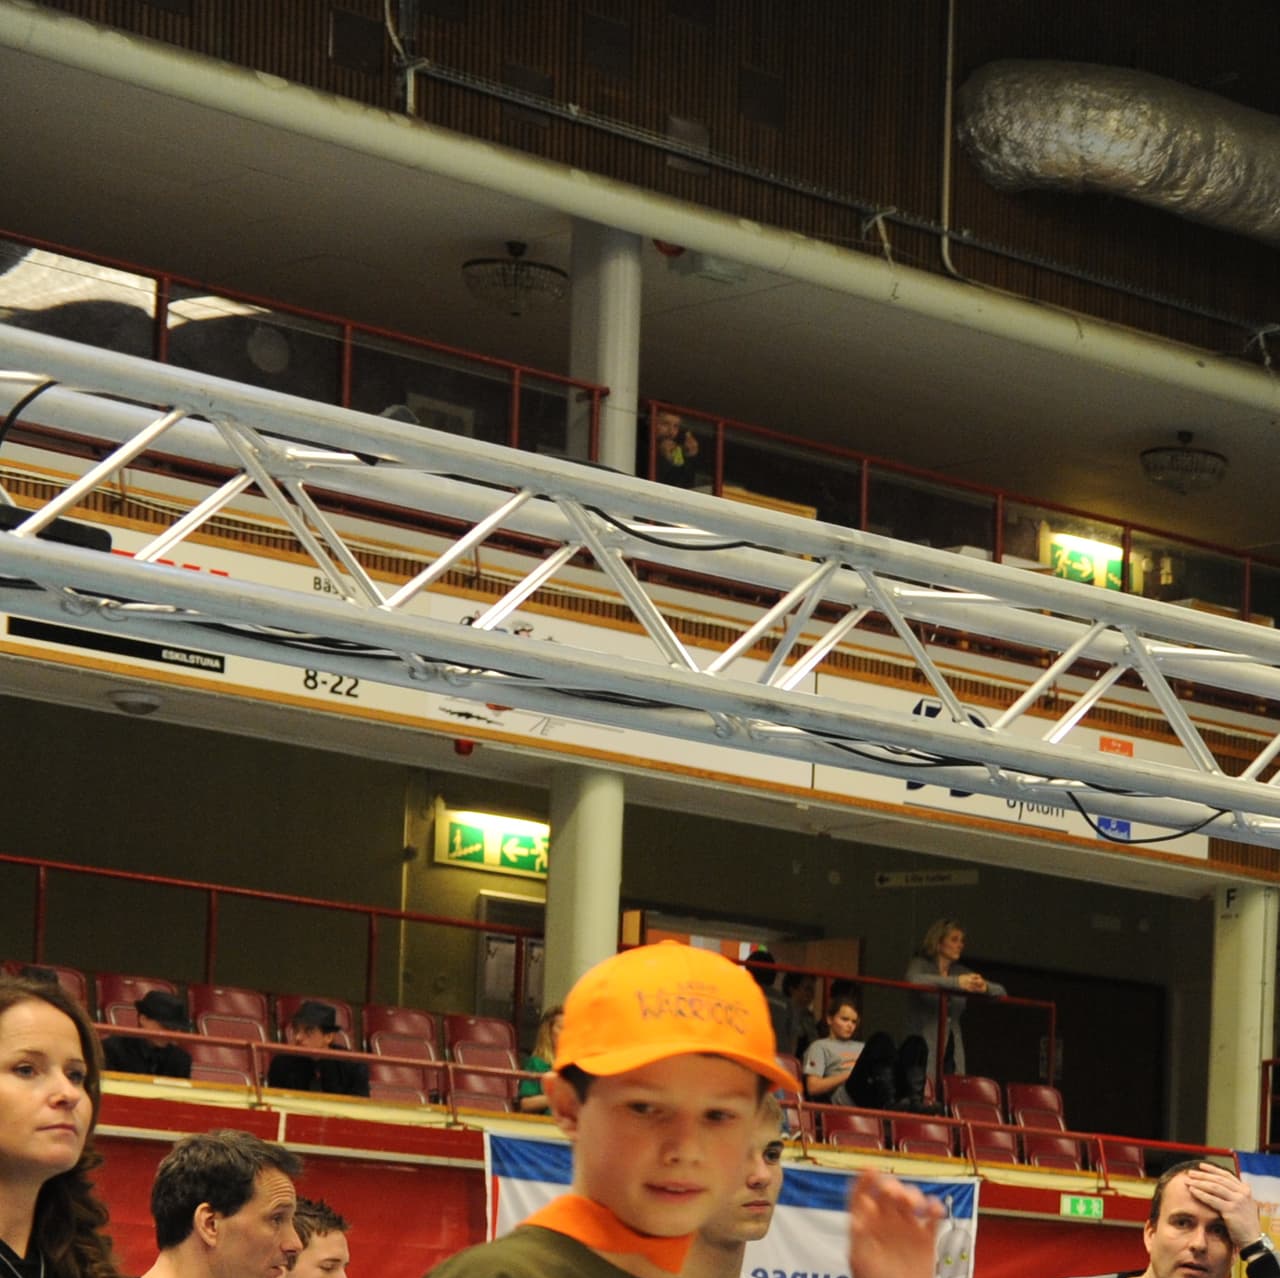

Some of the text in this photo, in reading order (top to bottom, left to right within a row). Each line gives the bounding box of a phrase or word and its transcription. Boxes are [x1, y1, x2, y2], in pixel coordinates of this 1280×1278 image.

[161, 648, 222, 669] ESKILSTUNA
[303, 668, 360, 698] 8-22
[1226, 888, 1238, 909] F
